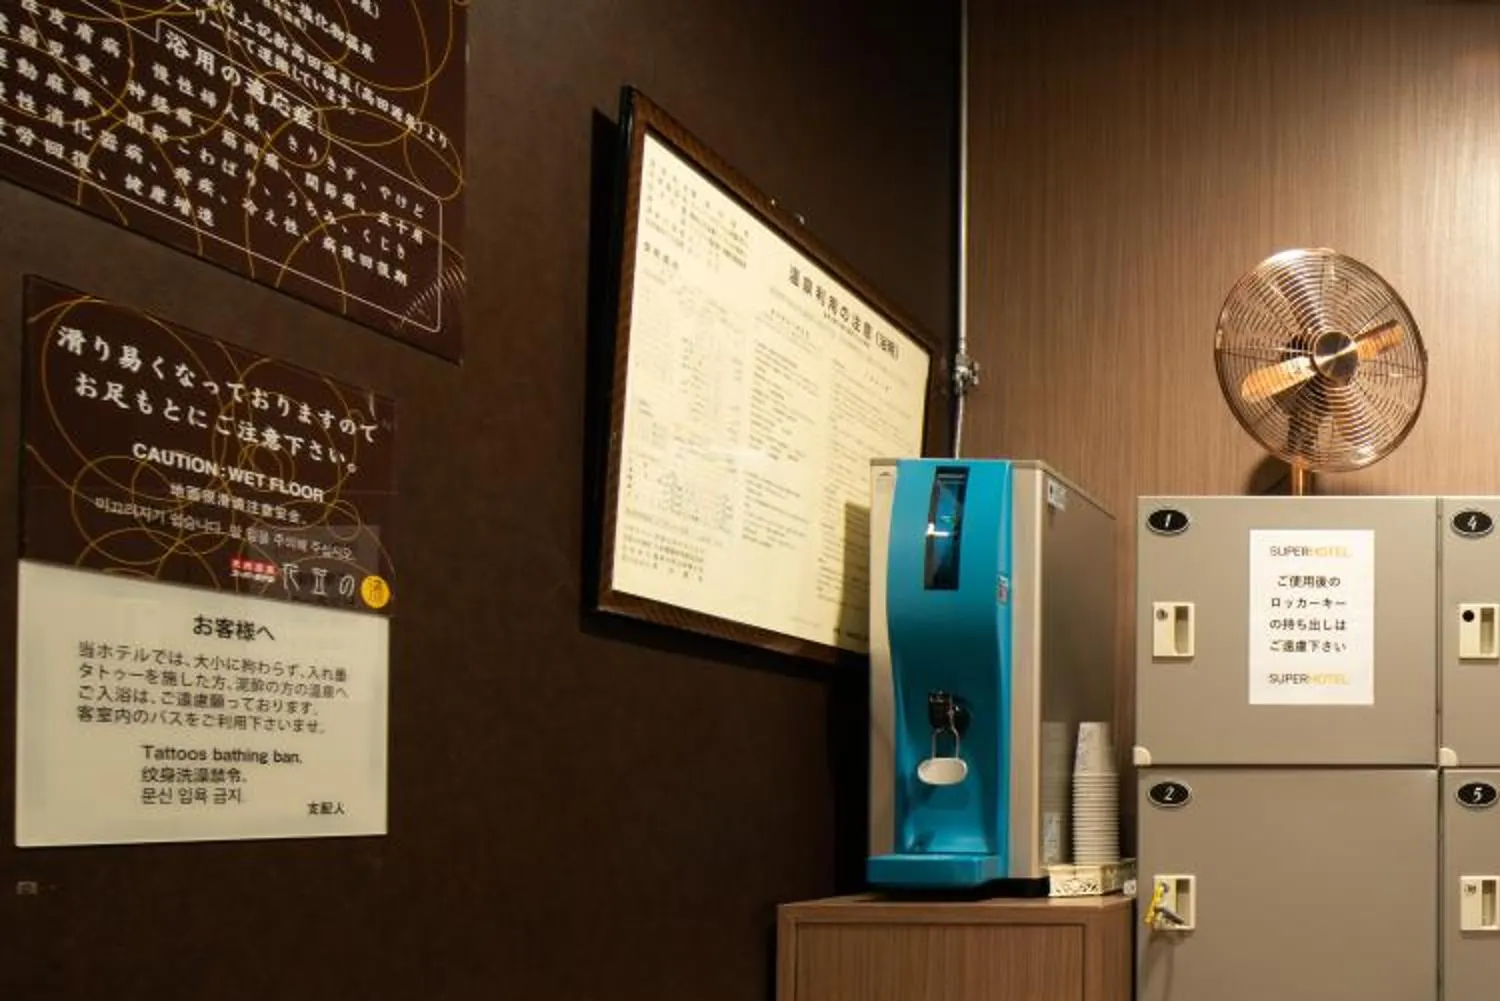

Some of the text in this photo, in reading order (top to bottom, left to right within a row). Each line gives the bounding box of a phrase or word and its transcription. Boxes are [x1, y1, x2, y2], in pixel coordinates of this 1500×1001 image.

[164, 30, 316, 131] 浴用の適応症
[228, 465, 267, 490] WET
[270, 477, 325, 503] FLOOR
[1468, 515, 1477, 530] 4
[1278, 575, 1341, 588] ご使用後の
[1271, 597, 1347, 609] ロッカーキー
[193, 614, 275, 641] お客様へ
[1269, 618, 1346, 631] の持ち出しは
[1269, 639, 1347, 653] ご遠慮下さい
[141, 745, 302, 764] Tattoos bathing ban.
[1164, 786, 1174, 801] 2
[1473, 787, 1483, 802] 5
[307, 801, 345, 815] 支配人
